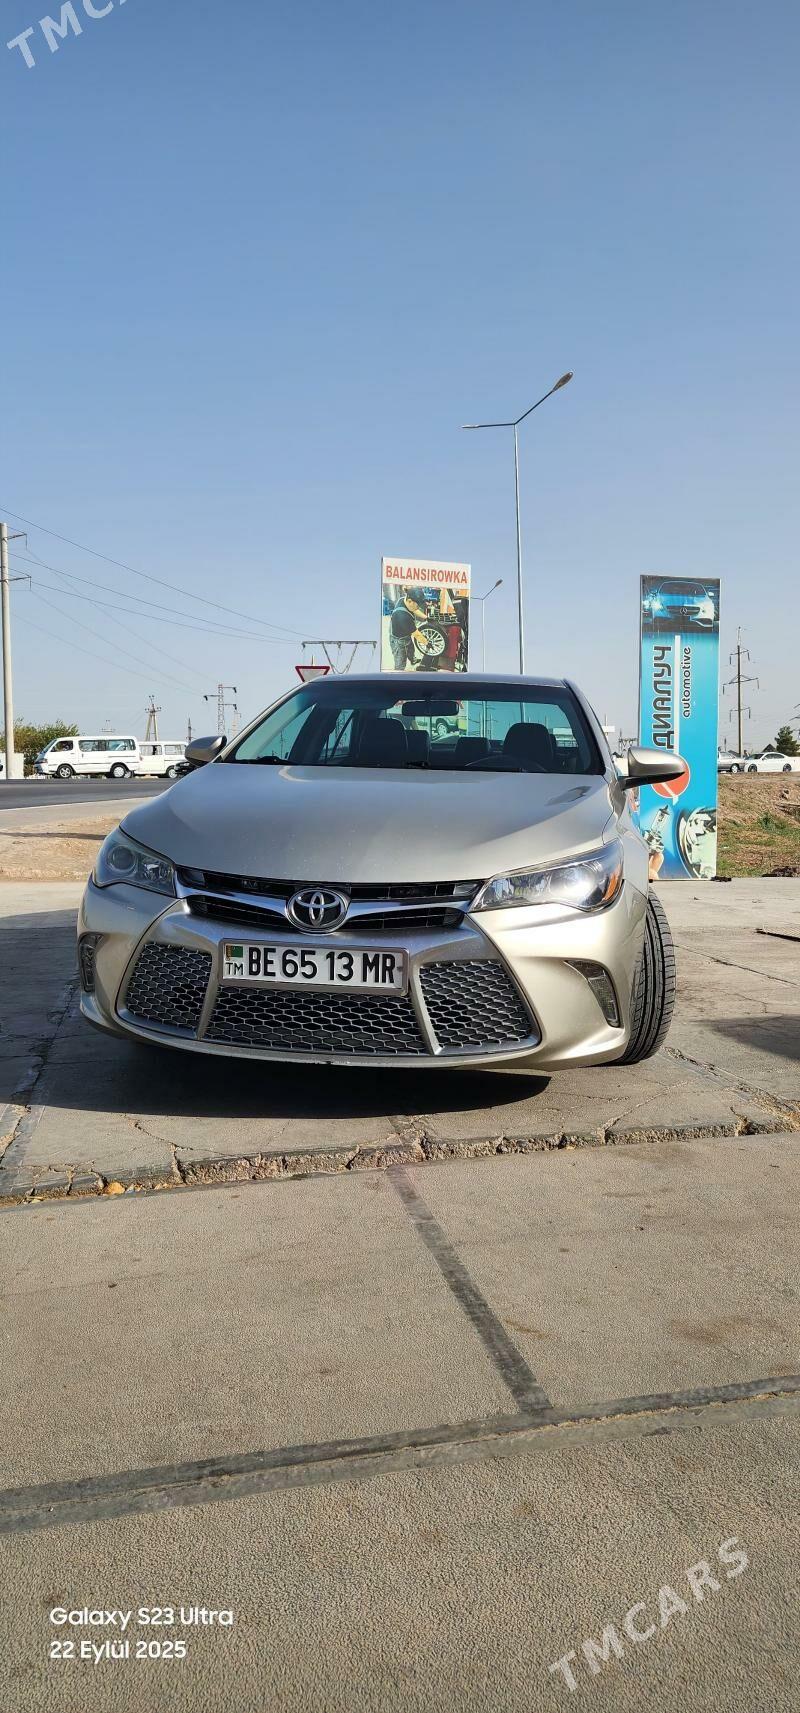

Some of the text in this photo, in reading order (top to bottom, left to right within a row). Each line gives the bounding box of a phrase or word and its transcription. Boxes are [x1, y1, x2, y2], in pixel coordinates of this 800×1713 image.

[386, 565, 468, 584] BALANSIROWKA
[652, 645, 675, 750] ДИАЛУЧ
[681, 646, 692, 718] automotive
[225, 962, 244, 976] TM
[248, 946, 396, 984] BE 65 13 MR
